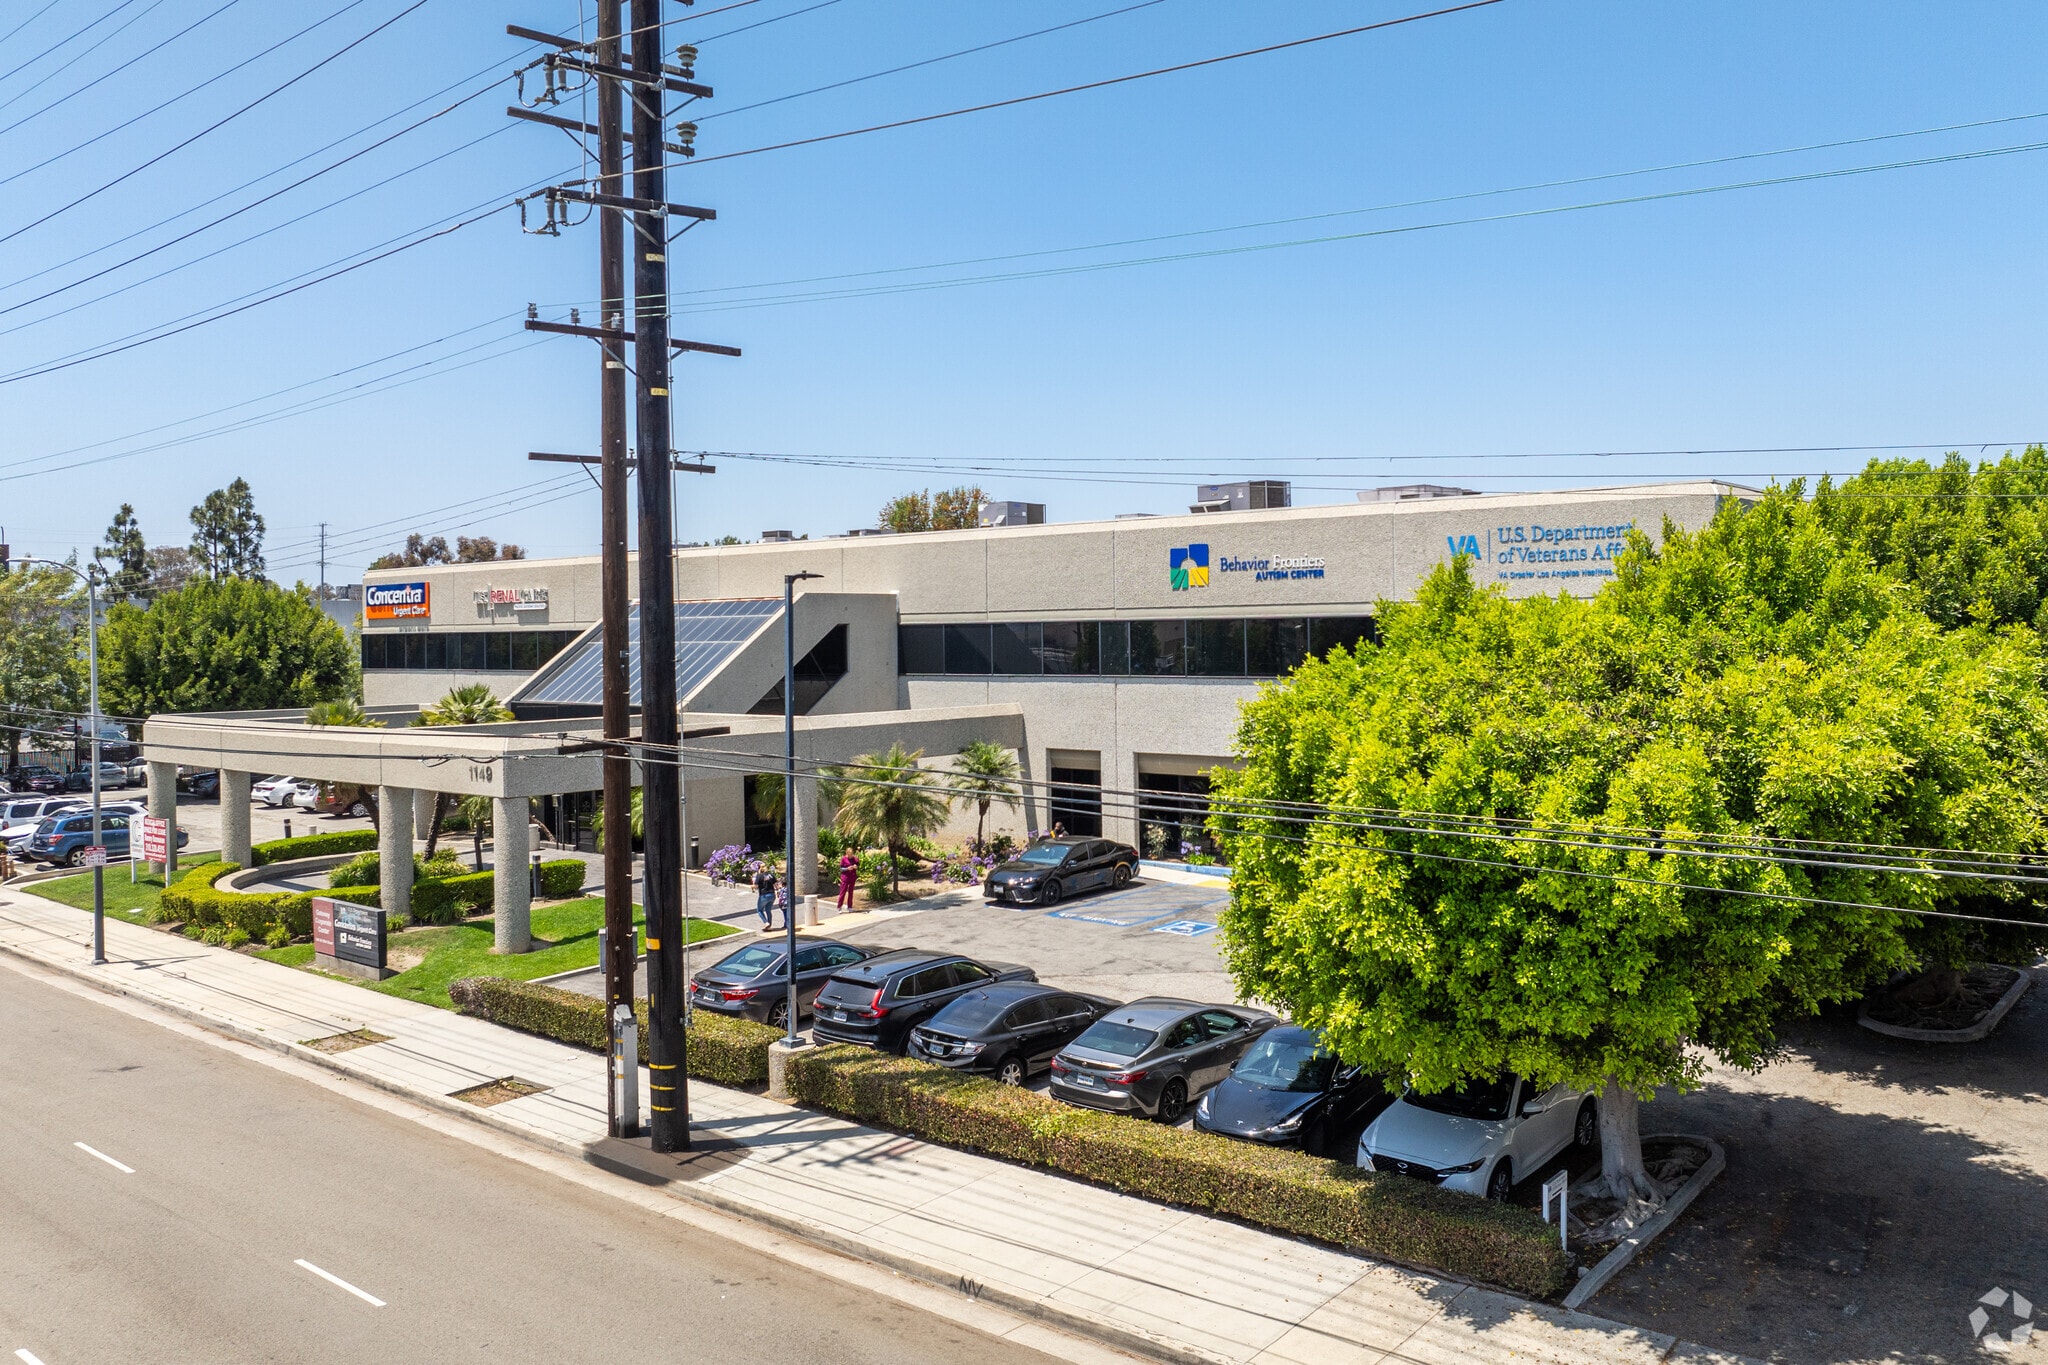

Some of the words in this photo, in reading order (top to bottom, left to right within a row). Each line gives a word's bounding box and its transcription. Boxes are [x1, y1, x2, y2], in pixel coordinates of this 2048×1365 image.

[1497, 526, 1527, 544] U.S.
[1531, 521, 1633, 545] Department
[1447, 534, 1482, 560] VA
[1498, 549, 1515, 564] of
[1517, 547, 1587, 563] Veterans
[1220, 556, 1270, 573] Behavior
[1273, 554, 1325, 569] Frontiers
[1256, 570, 1289, 582] AUTISM
[1291, 569, 1325, 580] CENTER
[367, 585, 423, 605] Concentra
[490, 589, 520, 603] RENAL
[393, 607, 411, 617] Urgent
[411, 606, 426, 616] Care
[469, 765, 493, 783] 1149
